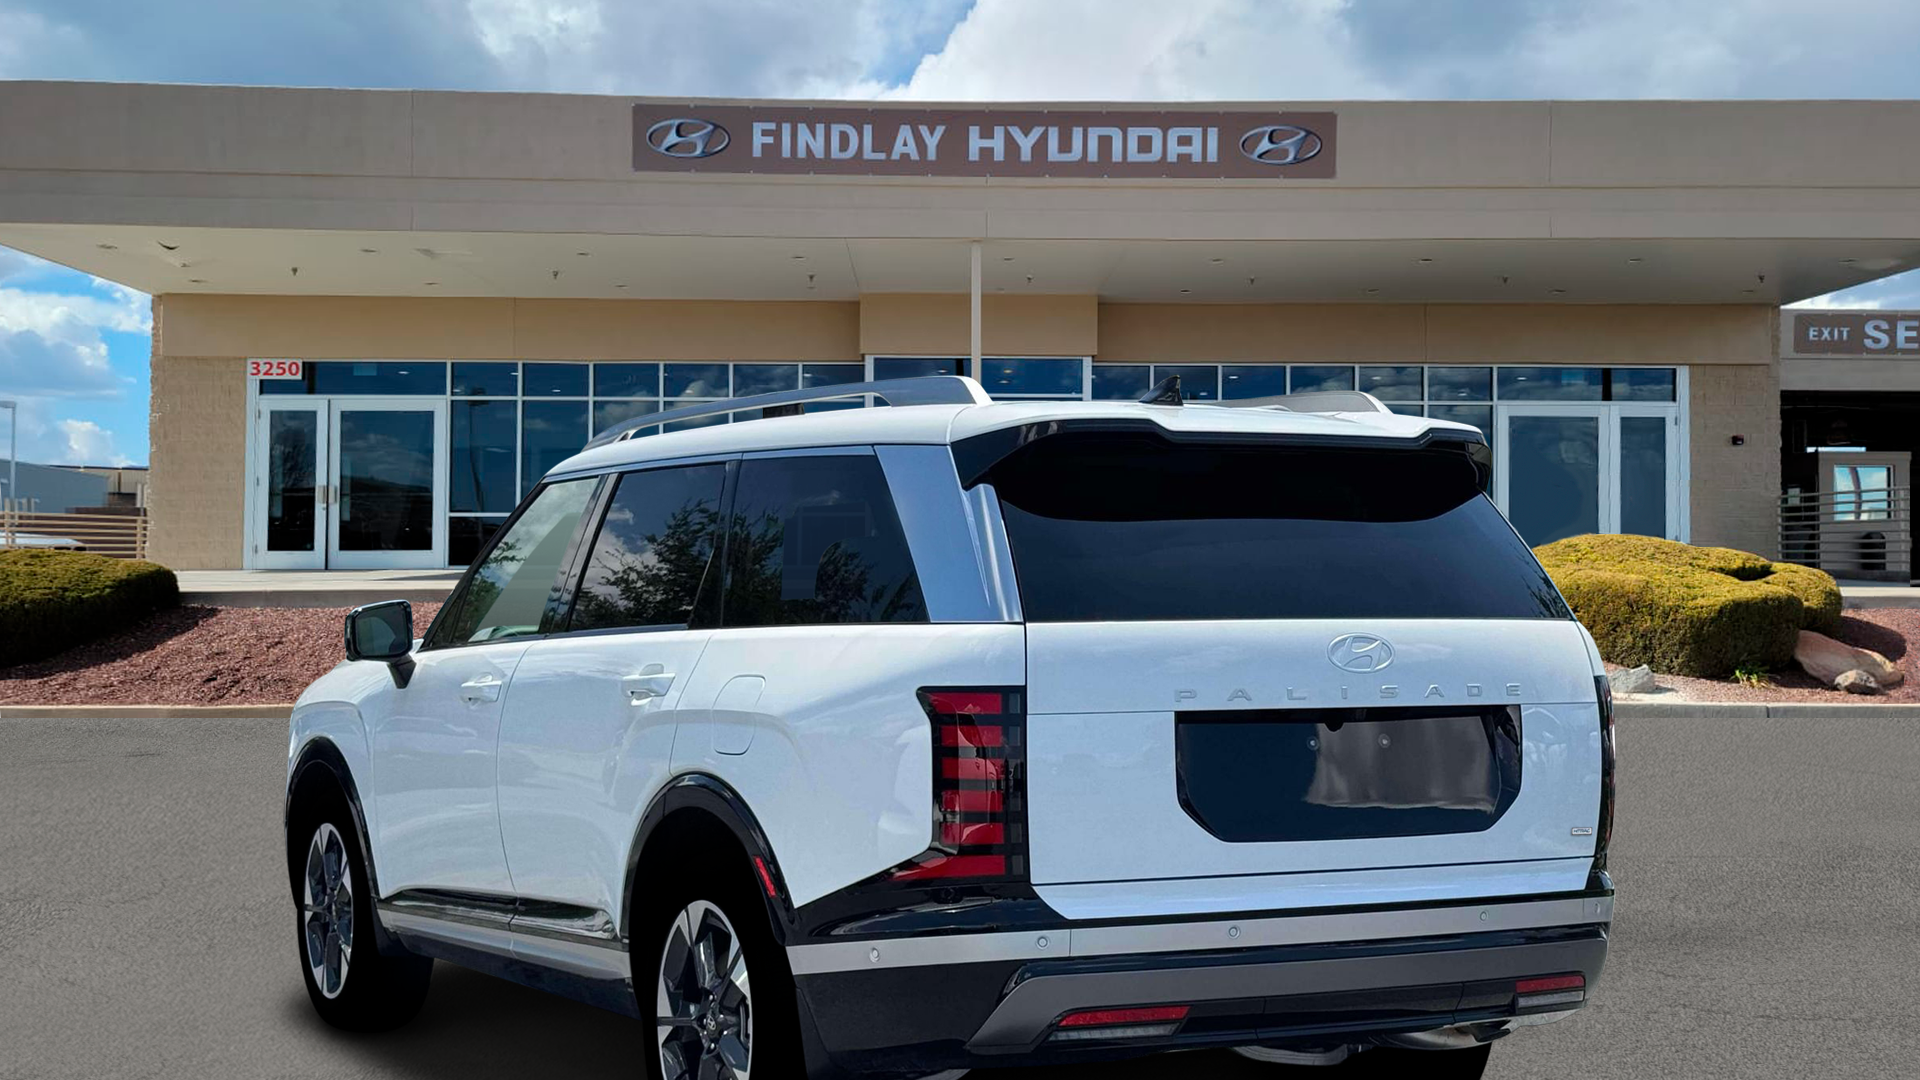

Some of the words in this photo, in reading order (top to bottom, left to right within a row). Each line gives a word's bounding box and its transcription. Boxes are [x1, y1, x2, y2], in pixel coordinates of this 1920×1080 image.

[751, 121, 946, 161] FINDLAY
[968, 125, 1219, 162] HYUNDAI
[1808, 326, 1851, 341] EXIT
[1863, 319, 1920, 350] SE
[249, 361, 300, 376] 3250
[1174, 682, 1522, 702] PALISADE
